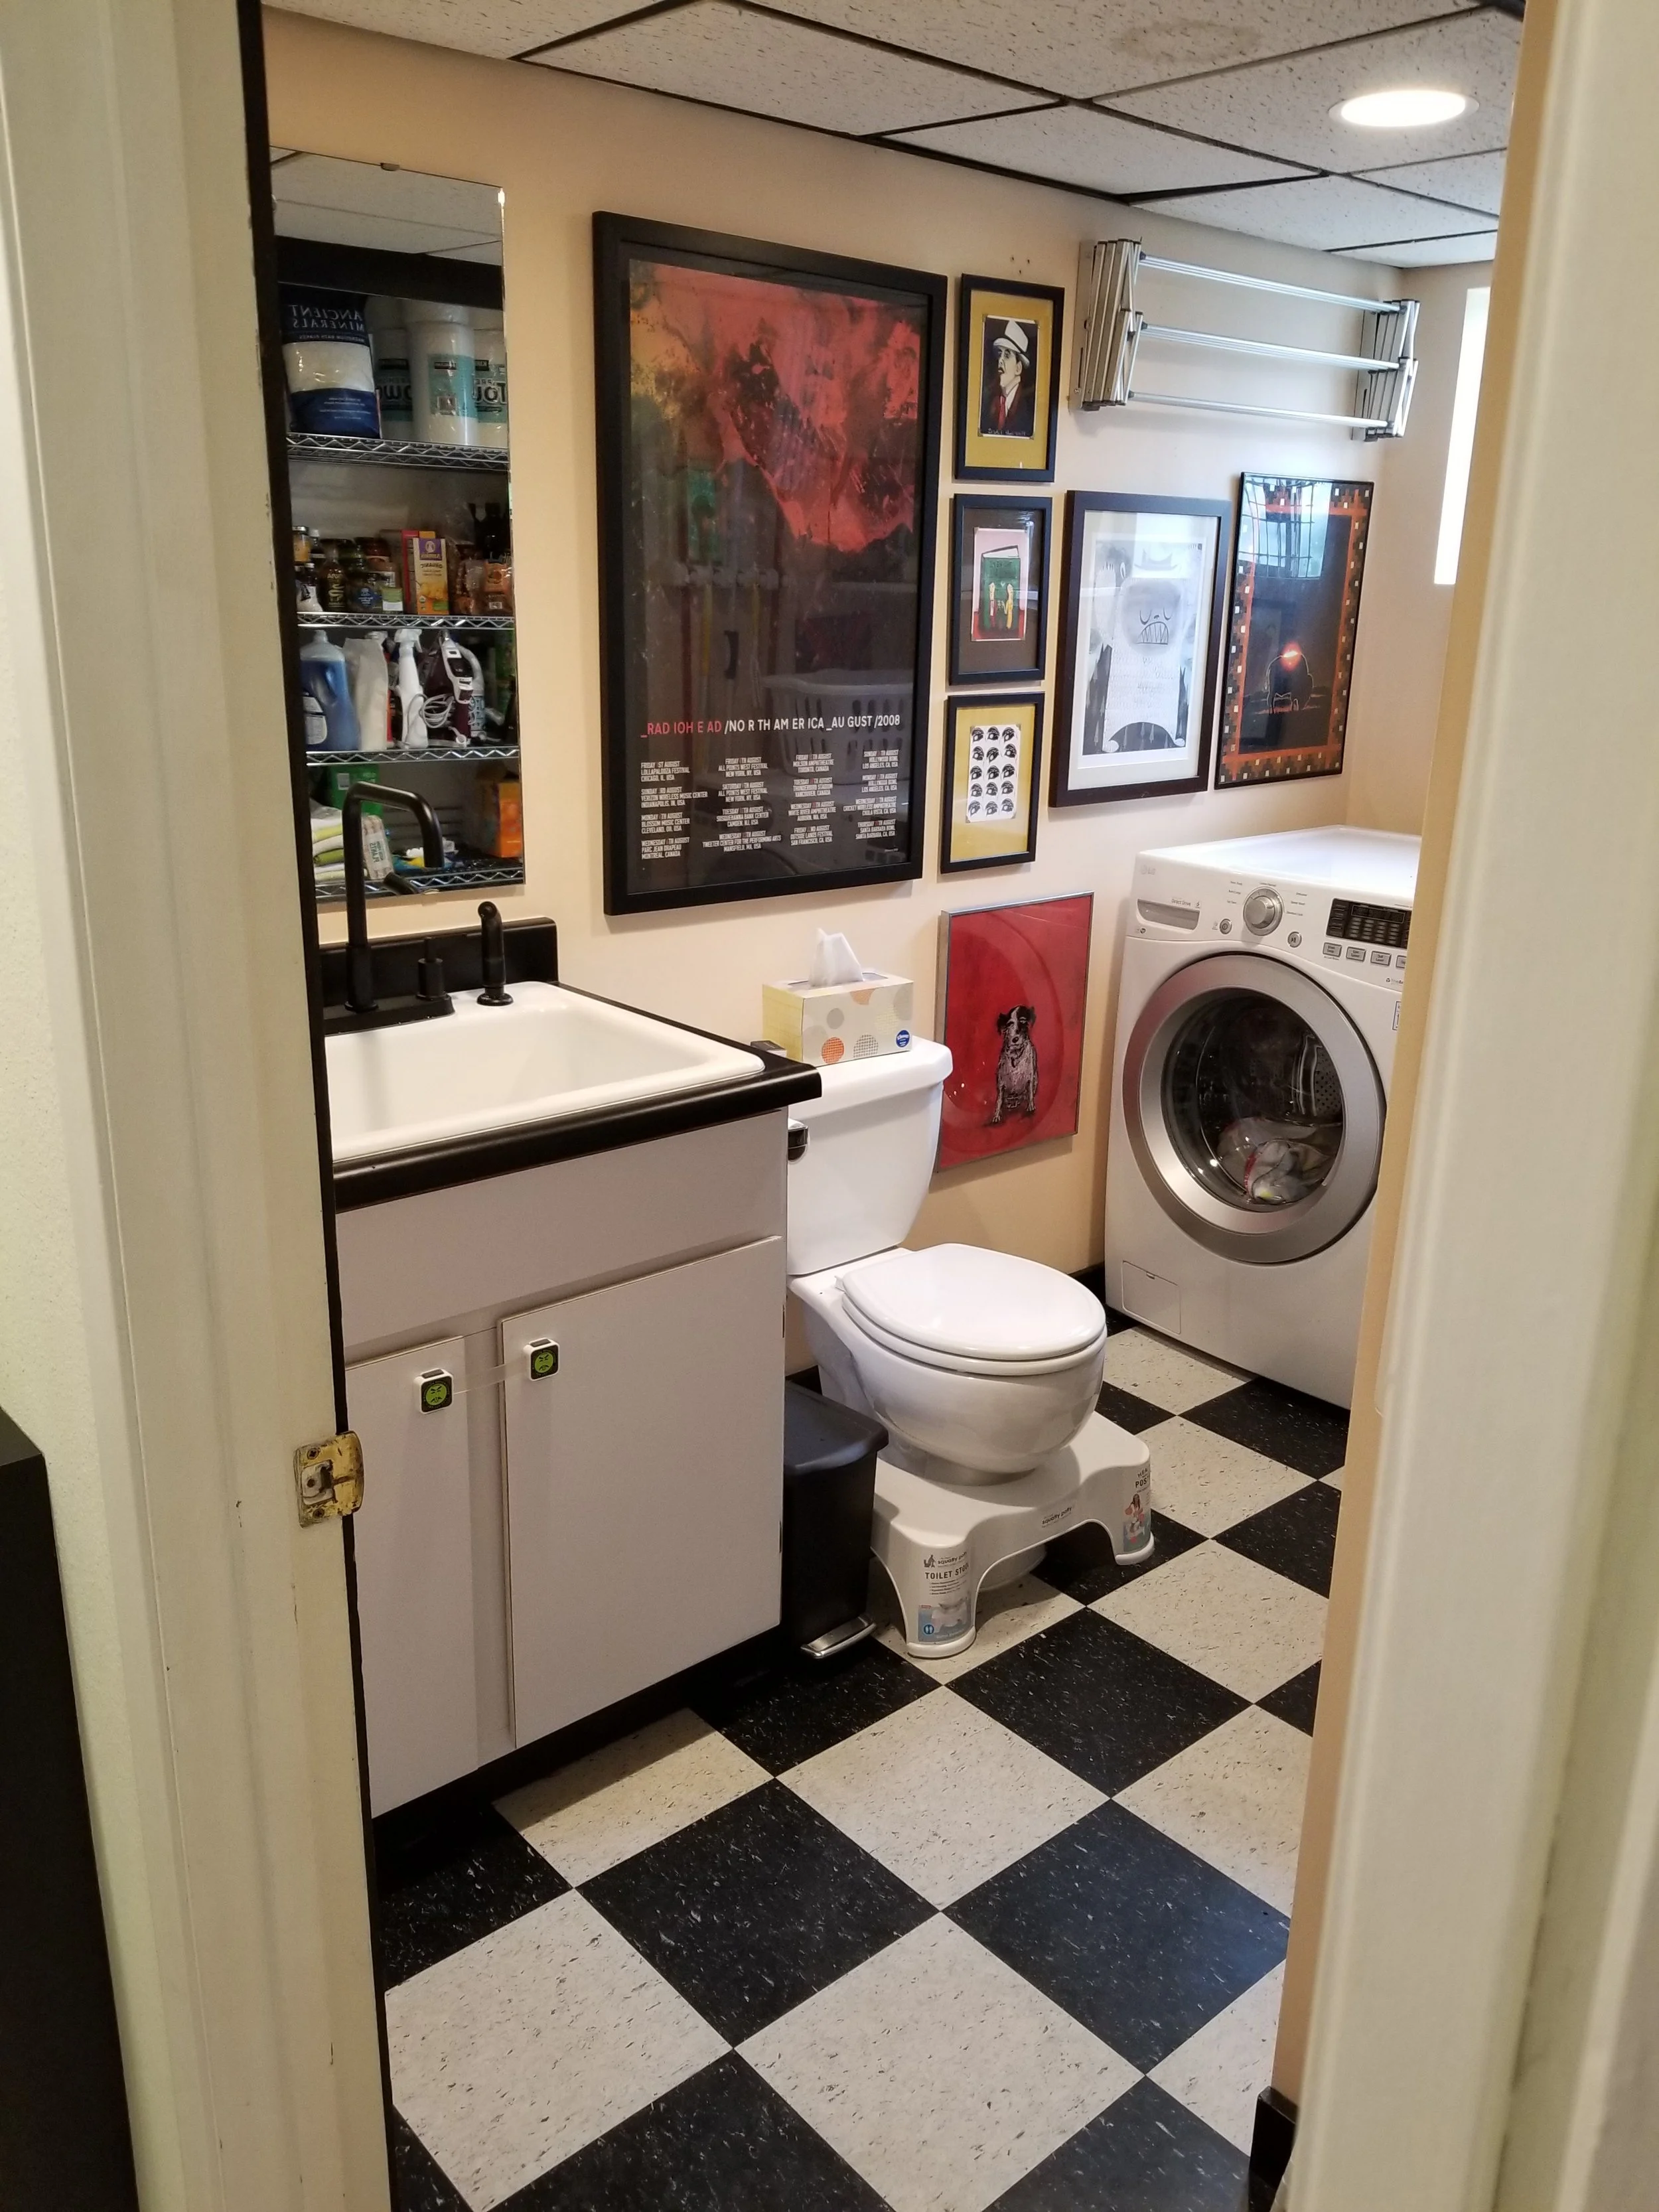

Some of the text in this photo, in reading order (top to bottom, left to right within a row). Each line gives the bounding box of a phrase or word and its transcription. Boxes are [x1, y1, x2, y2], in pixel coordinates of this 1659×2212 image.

[1137, 1468, 1147, 1477] HEA
[1135, 1477, 1148, 1488] POS
[925, 1570, 953, 1580] TOILET
